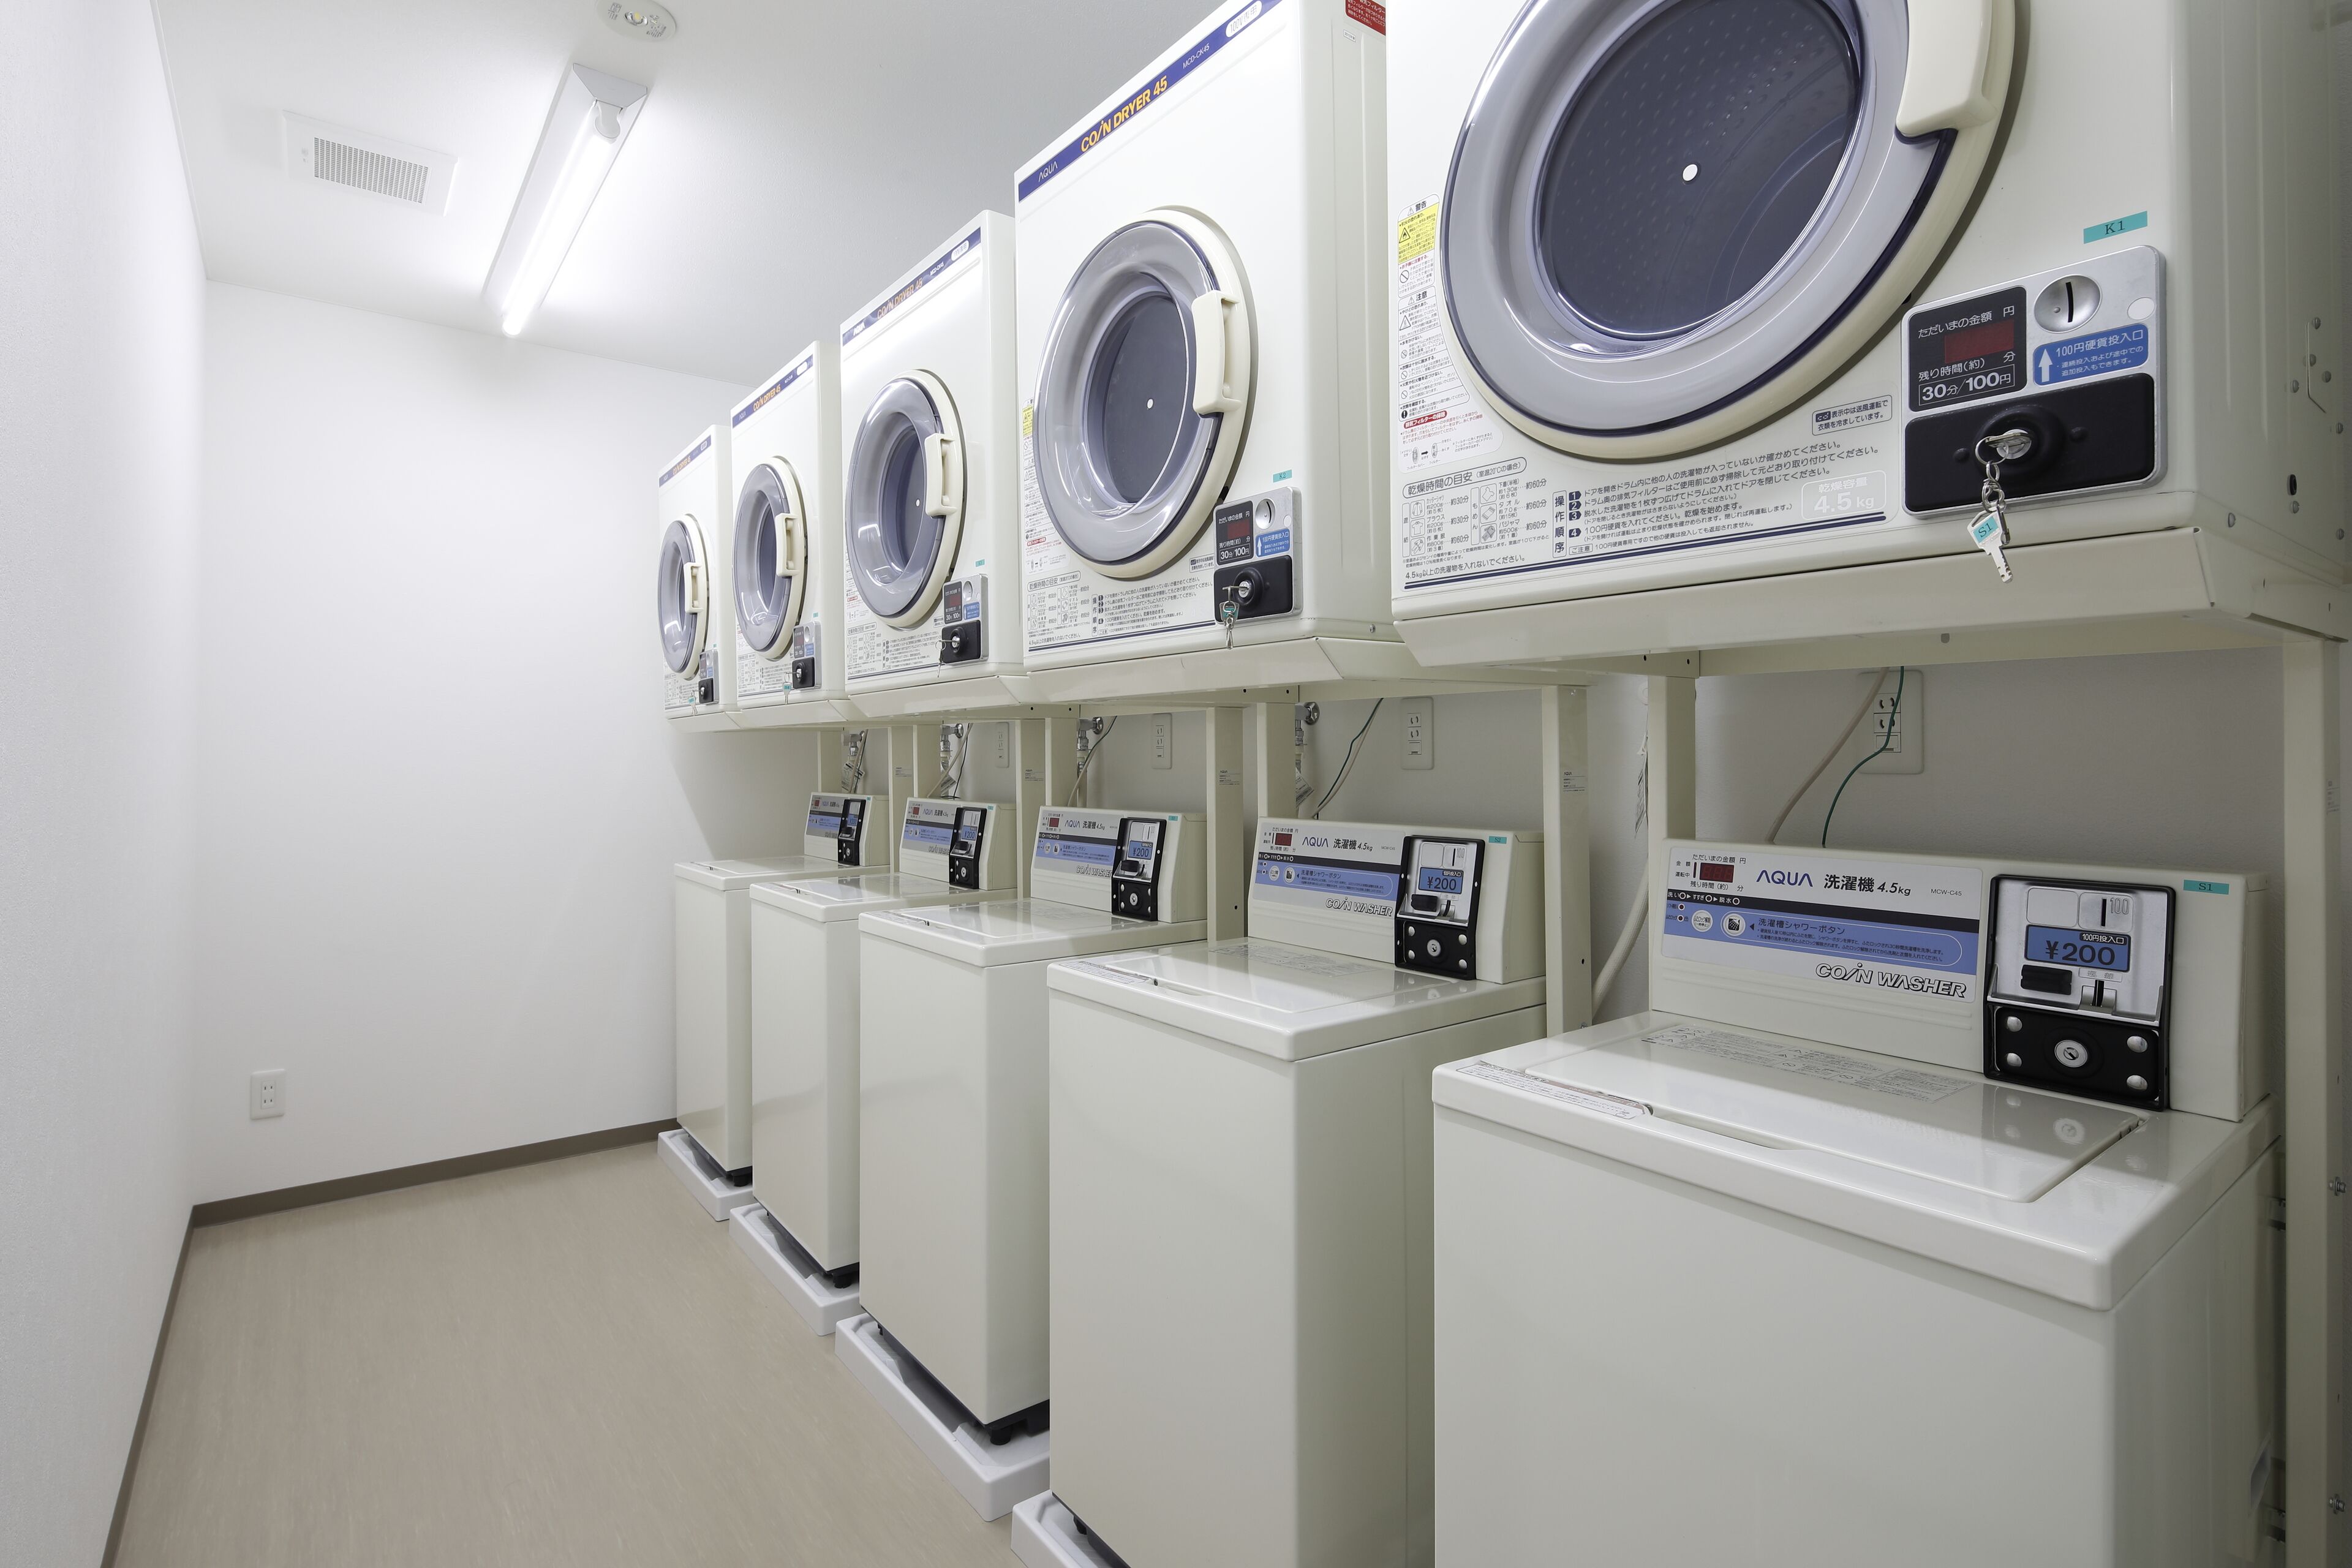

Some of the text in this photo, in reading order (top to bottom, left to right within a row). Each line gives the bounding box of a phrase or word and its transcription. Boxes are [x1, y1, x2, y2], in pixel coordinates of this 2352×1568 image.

[1038, 161, 1058, 183] AQUA
[1114, 91, 1151, 130] DRYER
[1153, 75, 1168, 96] 45
[1415, 201, 1427, 212] 警告
[2105, 220, 2125, 236] K1
[1416, 291, 1427, 301] 注意
[1918, 305, 2015, 339] ただいまの金額 円
[2056, 330, 2143, 357] 100円硬貨投入口
[2003, 351, 2015, 363] 分
[2062, 358, 2132, 377] 追加投入もできます。
[1921, 371, 2011, 402] 30分/100円
[1831, 399, 1888, 418] 表示中は送風運転で
[1818, 413, 1884, 431] 衣類を冷ましています。
[1585, 440, 1841, 497] ドアを開きドラム内に他の人の洗濯物が入っていないか確かめてください。
[1585, 446, 1879, 507] ドラム奥の排気フィルターはご使用前に必ず掃除して元どおり取り付けてください。
[1408, 472, 1472, 496] 乾燥時間の目安
[1818, 477, 1868, 494] 乾燥容量
[1814, 492, 1874, 513] 4.5 kg
[1555, 495, 1565, 554] 操作順序
[1978, 522, 1994, 538] S1
[1572, 545, 1590, 554] ご注意
[1405, 554, 1525, 579] 4.5kg以上の洗濯物を入れないでください。
[1133, 848, 1149, 858] ¥200
[1302, 837, 1329, 848] AQUA
[1333, 838, 1357, 850] 洗濯機
[1357, 842, 1373, 852] 4.5kg
[1692, 854, 1735, 864] ただいまの金額
[1427, 876, 1457, 891] ¥200
[1757, 869, 1813, 887] AQUA
[1823, 873, 1874, 892] 洗濯機
[1877, 881, 1912, 897] 4.5kg
[2198, 883, 2214, 892] S1
[1354, 902, 1393, 916] WASHER
[2110, 897, 2130, 915] 100
[1758, 918, 1845, 935] 洗濯槽シャワーボタン
[2082, 933, 2125, 944] 100円投入口
[2045, 940, 2116, 965] ¥200
[1877, 971, 1967, 998] WASHER
